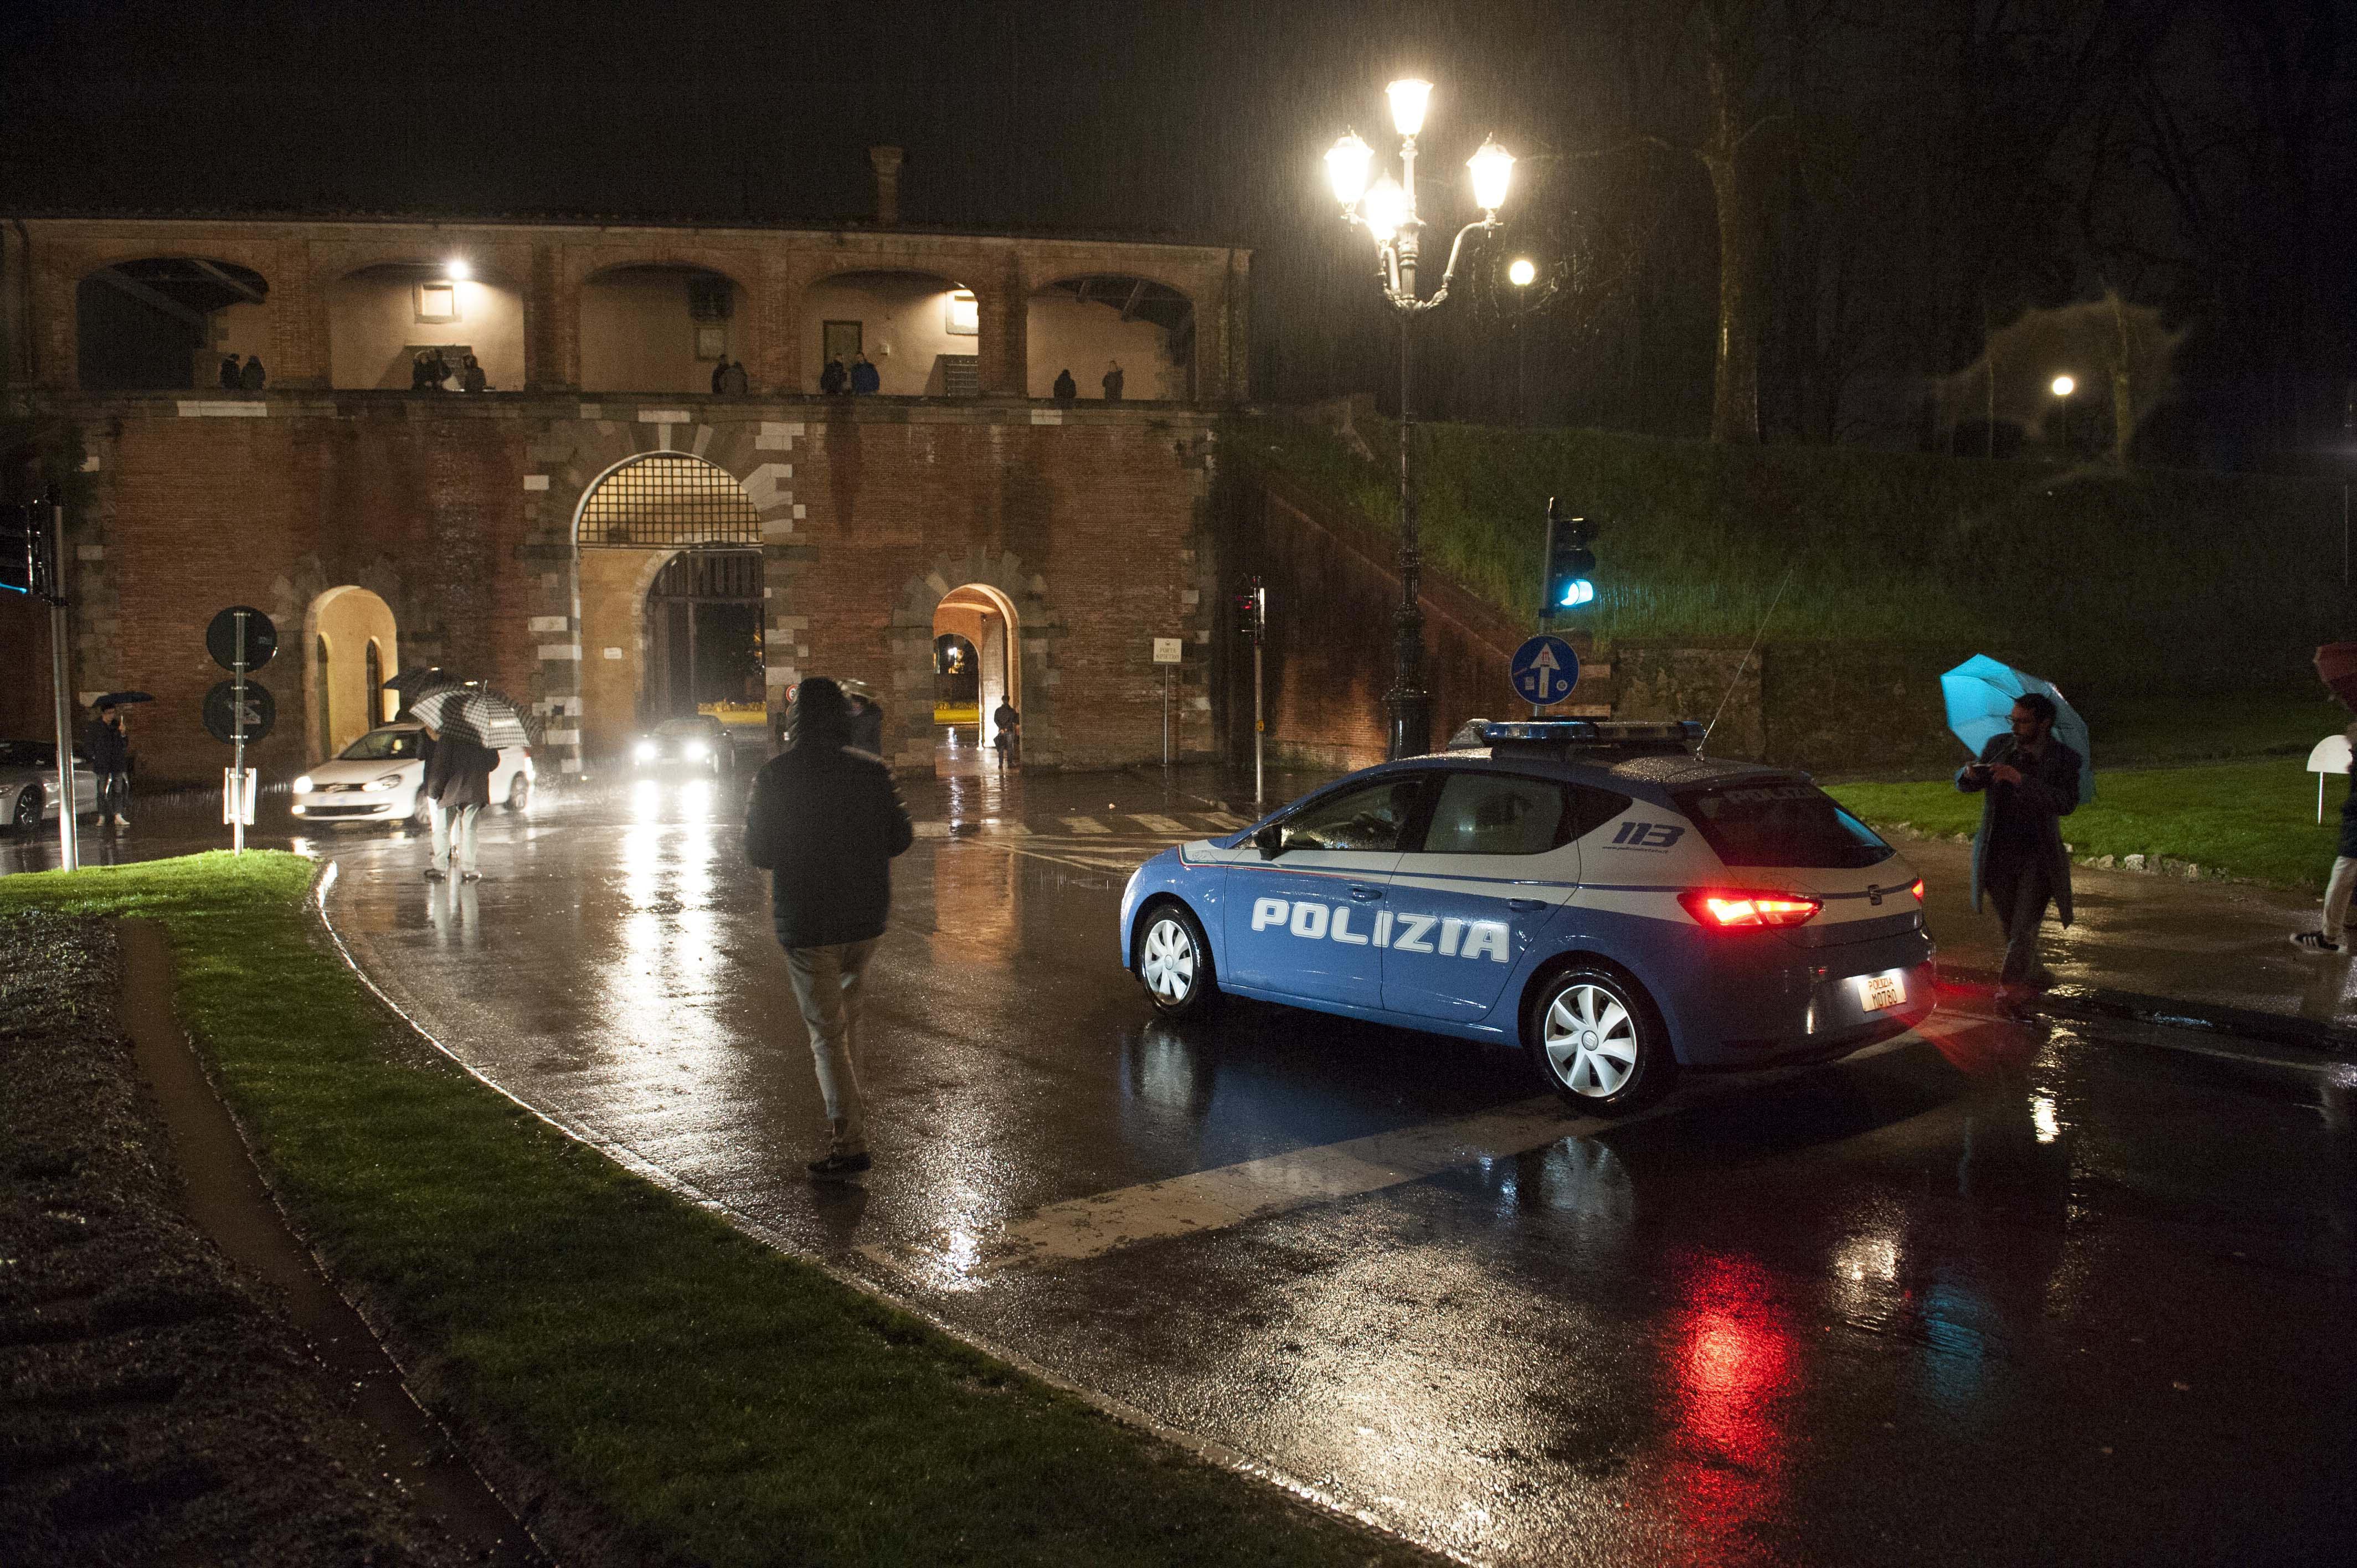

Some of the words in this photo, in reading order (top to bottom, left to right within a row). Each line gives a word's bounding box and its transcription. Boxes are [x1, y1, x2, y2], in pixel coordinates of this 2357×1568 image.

[1612, 821, 1686, 847] 113
[1251, 897, 1510, 963] POLIZIA
[1869, 977, 1893, 990] POLIZIA
